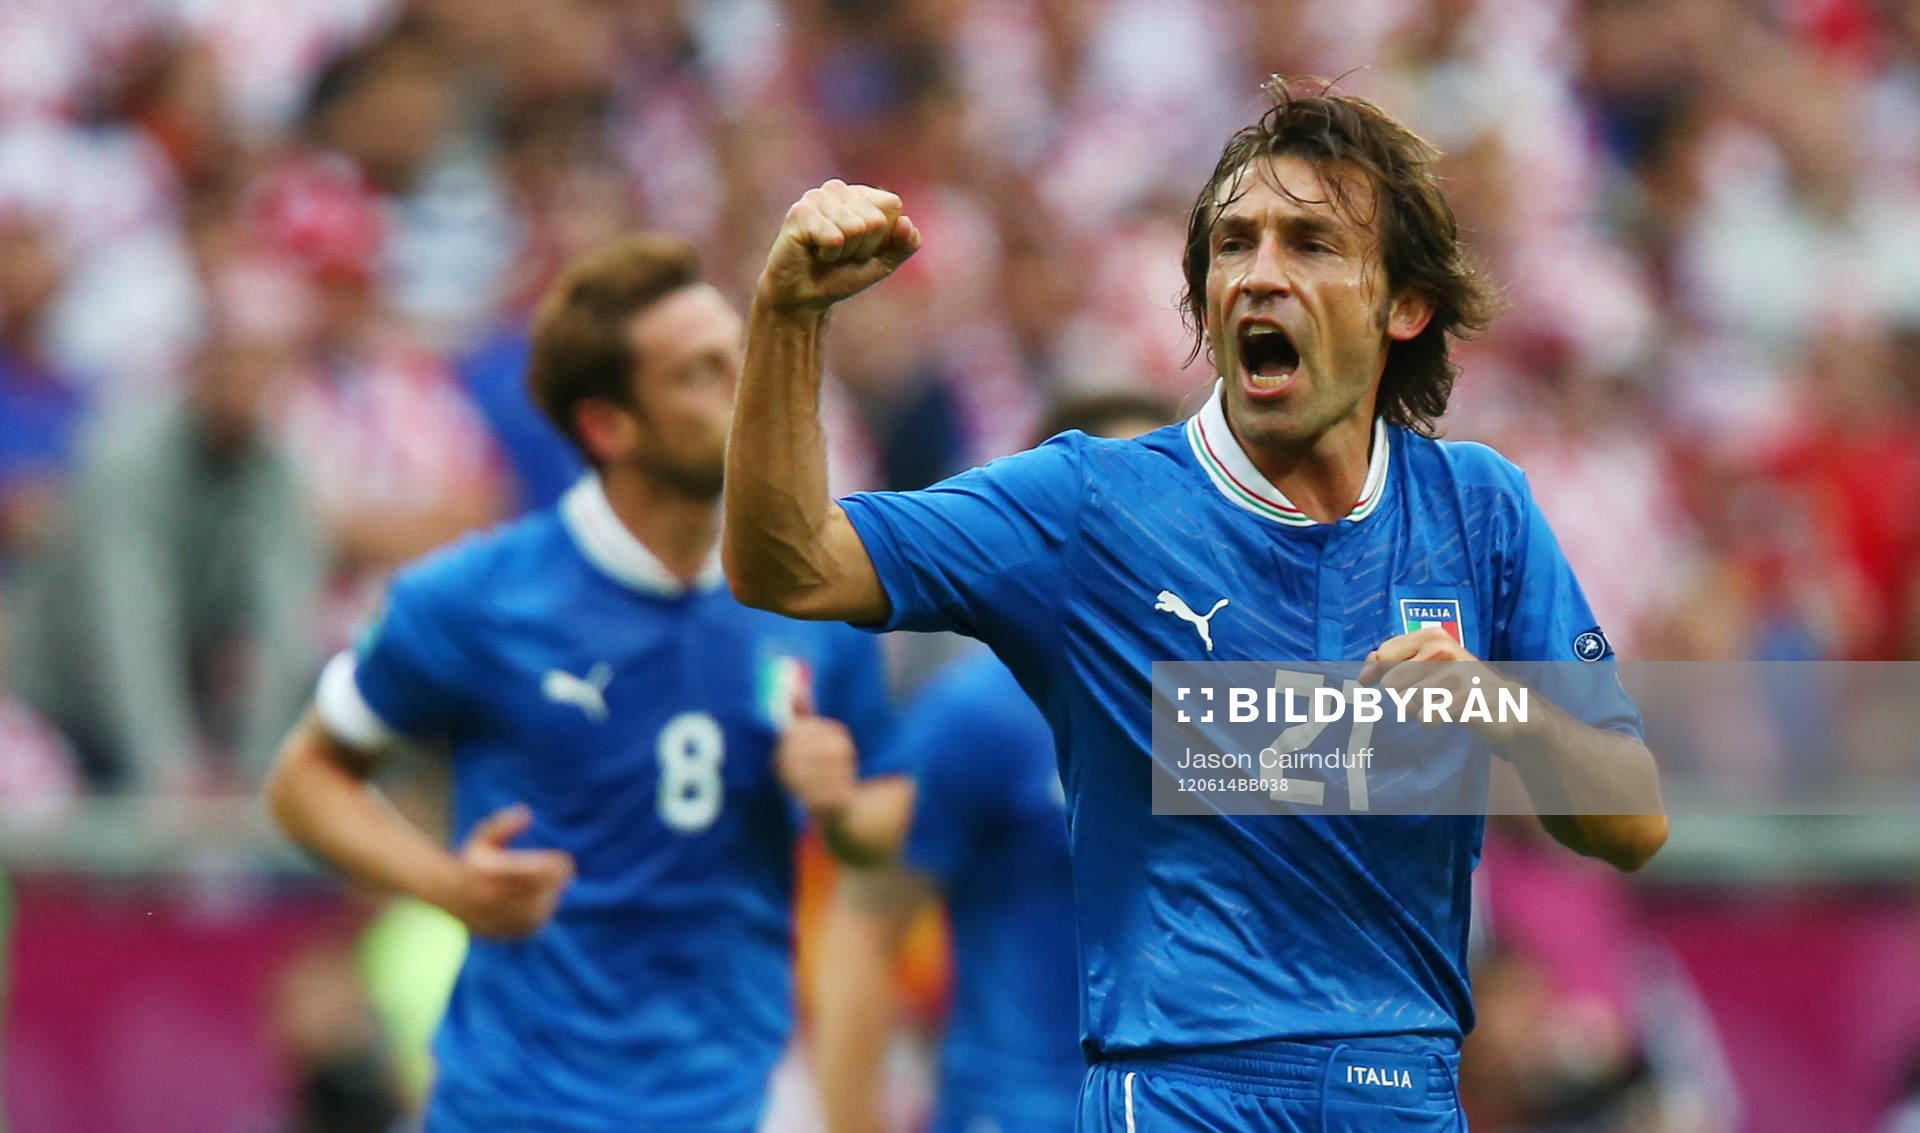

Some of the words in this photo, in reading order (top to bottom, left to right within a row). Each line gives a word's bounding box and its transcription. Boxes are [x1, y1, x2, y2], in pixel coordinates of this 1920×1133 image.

[1408, 607, 1451, 618] ITALIA
[656, 710, 726, 835] 8
[1259, 668, 1375, 812] 21
[1346, 1065, 1412, 1089] ITALIA
